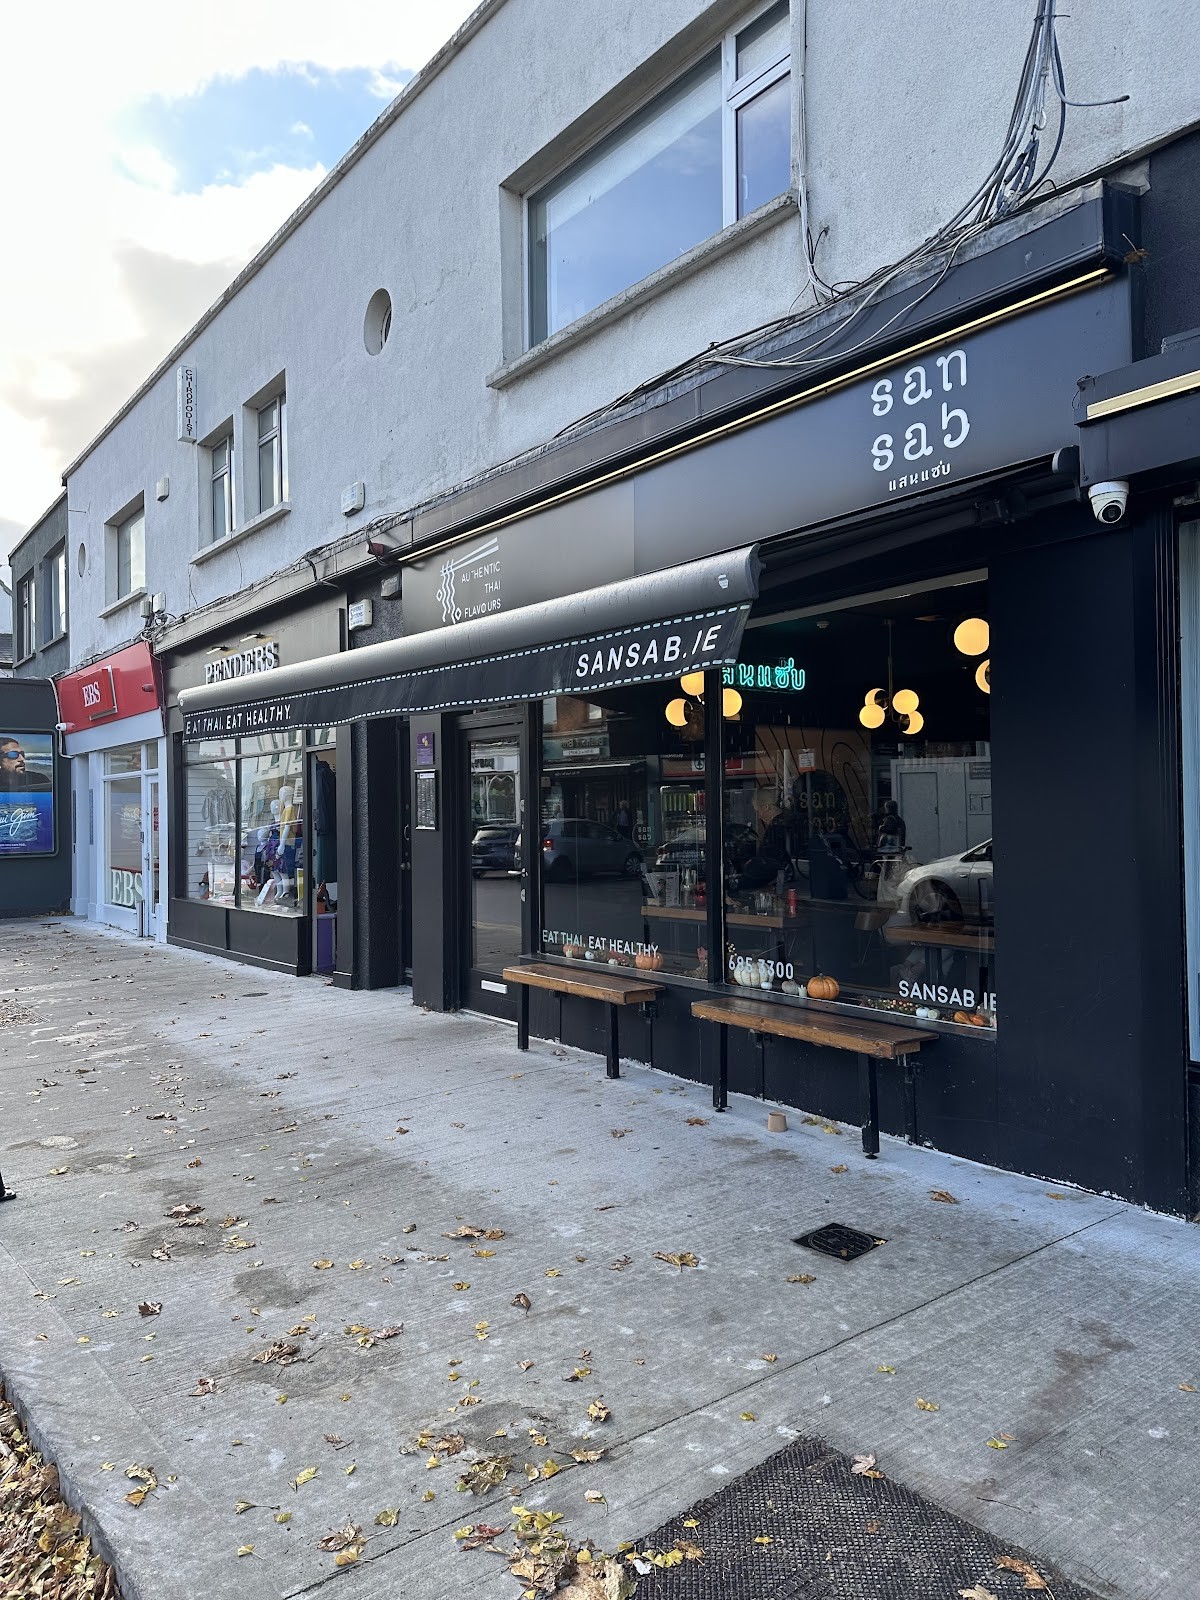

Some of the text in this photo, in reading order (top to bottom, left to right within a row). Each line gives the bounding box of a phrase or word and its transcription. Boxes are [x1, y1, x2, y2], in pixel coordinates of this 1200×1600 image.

[871, 350, 967, 416] san
[185, 369, 193, 436] CHIROPODIST
[871, 402, 970, 471] sab
[889, 460, 951, 491] แสนแซ่บ
[484, 580, 501, 593] THAI
[464, 598, 501, 618] FLAVOURS
[204, 641, 277, 685] PENDERS
[576, 624, 722, 678] SANSAB.IE
[82, 681, 101, 707] EBS
[185, 719, 201, 735] EAT
[226, 712, 243, 730] EAT
[542, 929, 559, 944] EAT
[588, 936, 607, 950] EAT
[728, 954, 794, 980] 685 3300
[898, 980, 997, 1012] SANSAB.IE
